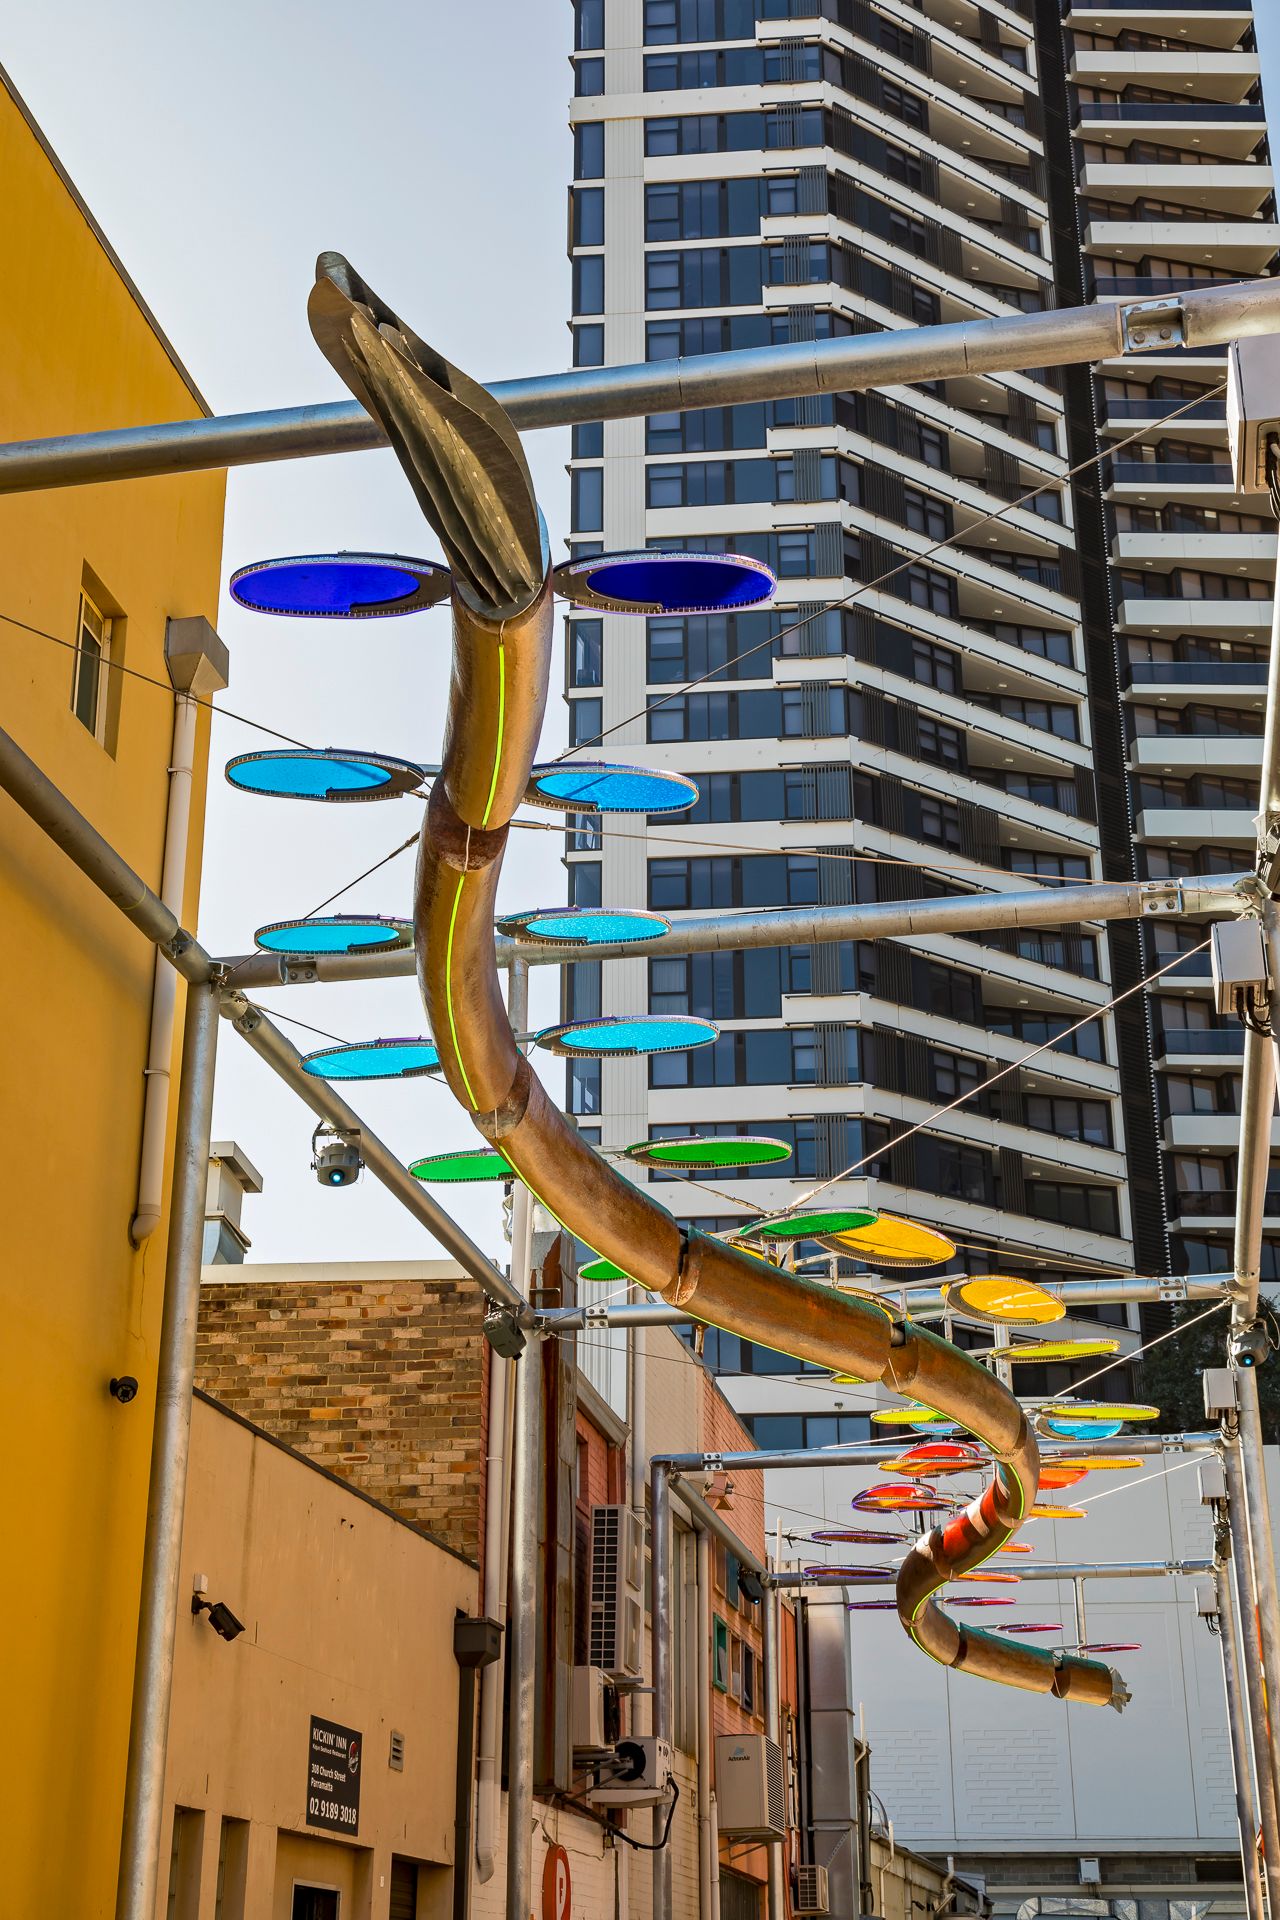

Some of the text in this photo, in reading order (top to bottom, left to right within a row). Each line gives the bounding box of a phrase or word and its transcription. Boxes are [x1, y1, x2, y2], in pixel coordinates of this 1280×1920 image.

[313, 1728, 347, 1750] KICKIN' INN
[311, 1763, 346, 1783] 308 Church Street
[311, 1777, 333, 1792] Parramatta
[310, 1797, 357, 1825] 02 9189 3018
